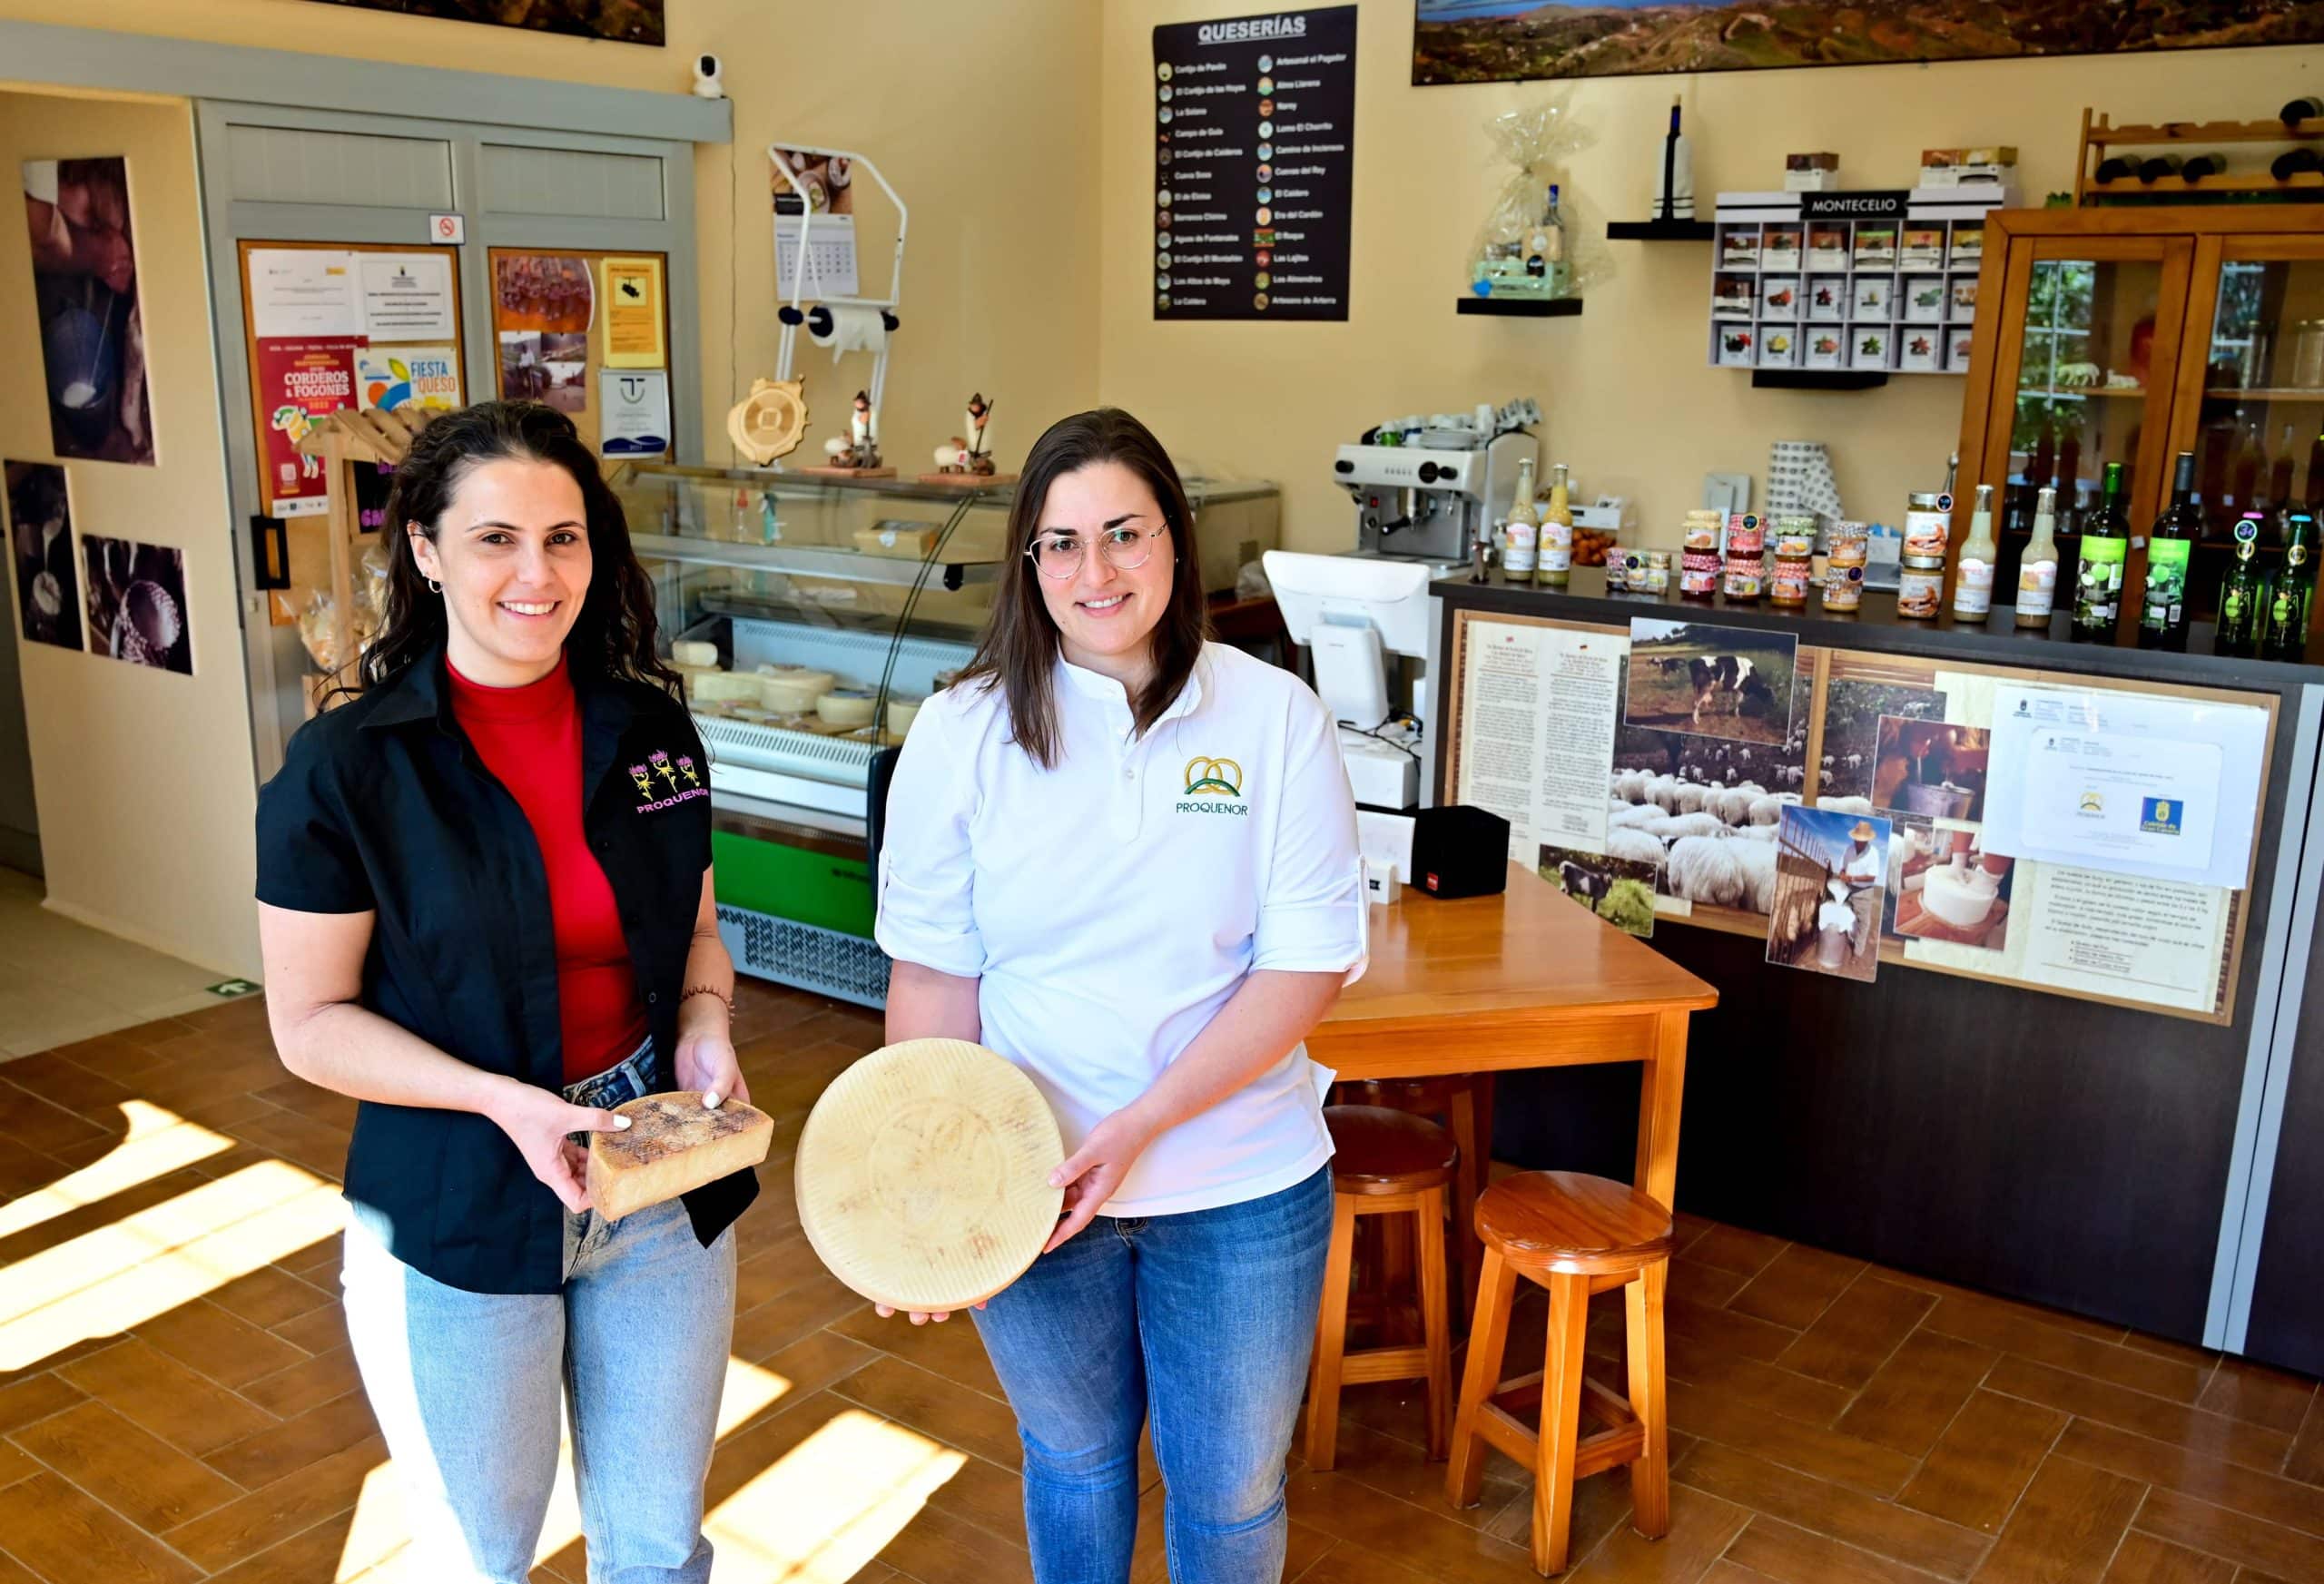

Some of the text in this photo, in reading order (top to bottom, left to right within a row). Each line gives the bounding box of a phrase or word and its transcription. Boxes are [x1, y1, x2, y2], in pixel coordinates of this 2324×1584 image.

[1197, 15, 1306, 42] QUESERÍAS
[1812, 199, 1896, 212] MONTECELIO
[283, 369, 350, 385] CORDEROS
[410, 361, 448, 378] FIESTA
[293, 383, 350, 398] FOGONES
[418, 378, 456, 393] QUESO
[1176, 802, 1248, 816] PROQUENOR
